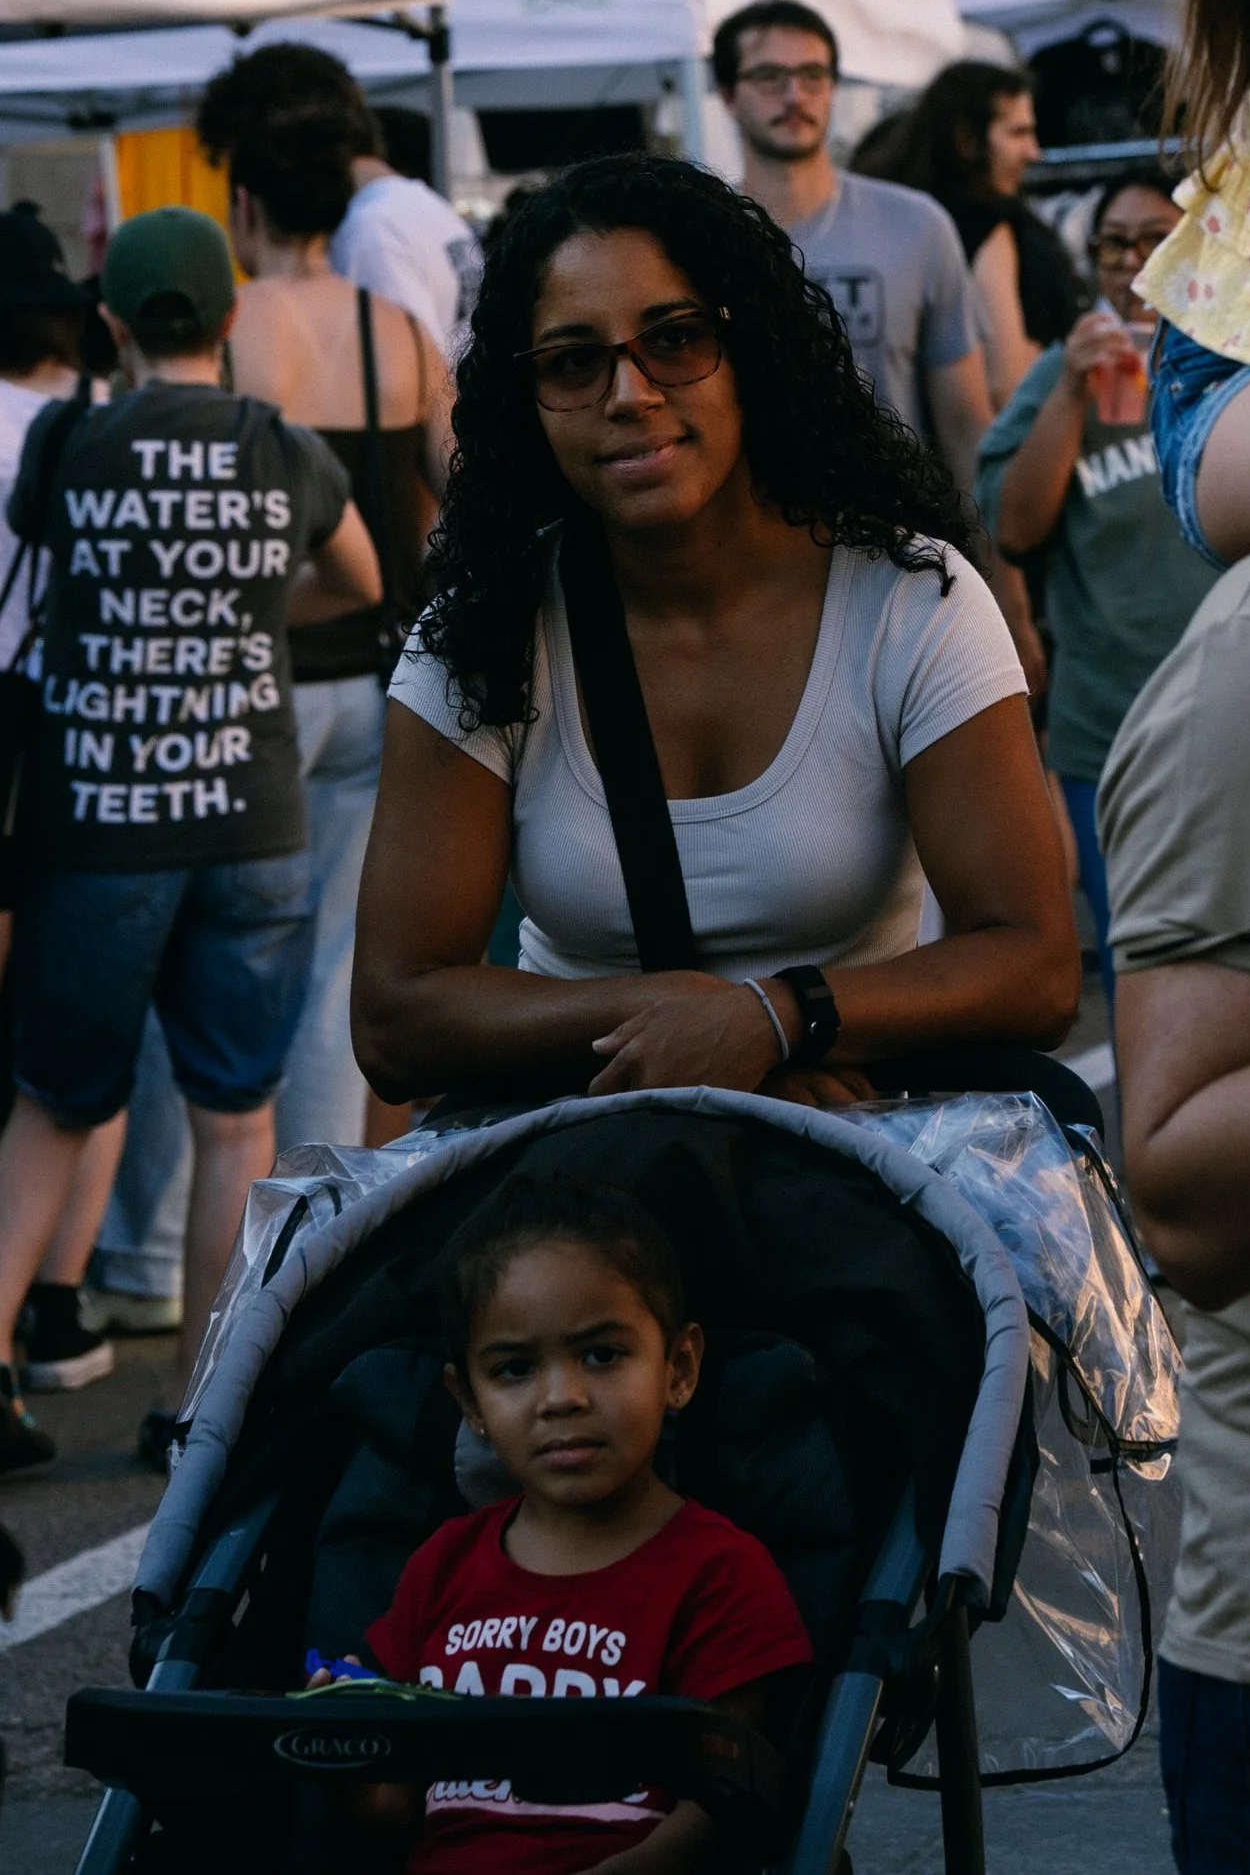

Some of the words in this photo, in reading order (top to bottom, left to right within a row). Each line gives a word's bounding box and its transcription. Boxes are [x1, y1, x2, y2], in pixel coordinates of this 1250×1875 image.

[132, 439, 239, 480] THE
[64, 488, 292, 529] WATER'S
[70, 539, 132, 578] AT
[150, 538, 291, 579] YOUR
[99, 588, 253, 632] NECK,
[78, 631, 273, 676] THERE'S
[43, 674, 281, 725] LIGHTNING
[64, 727, 114, 771] IN
[130, 726, 251, 772] YOUR
[71, 776, 246, 824] TEETH.
[445, 1615, 539, 1656] SORRY
[542, 1618, 627, 1667] BOYS
[291, 1735, 379, 1757] GRACO
